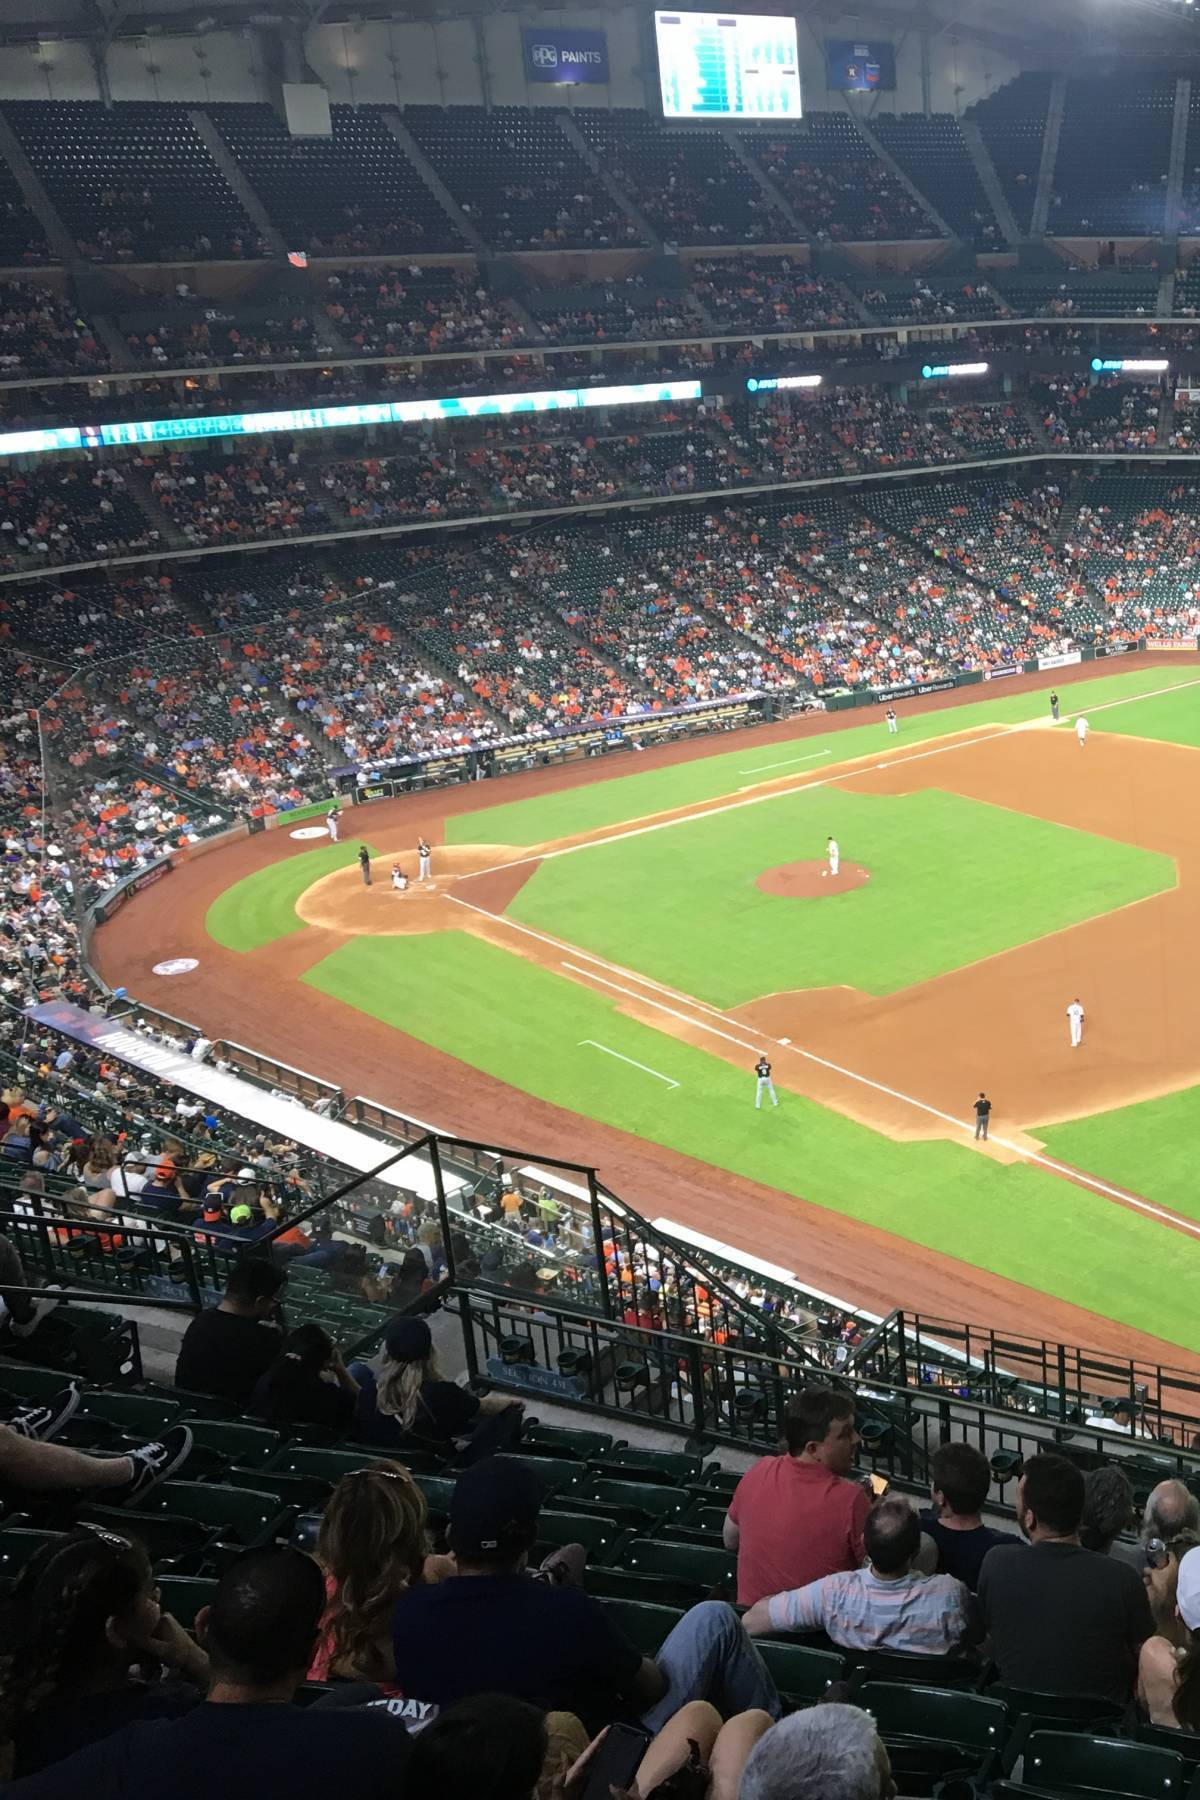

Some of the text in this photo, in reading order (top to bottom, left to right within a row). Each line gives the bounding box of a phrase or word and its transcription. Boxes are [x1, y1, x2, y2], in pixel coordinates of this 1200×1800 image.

[562, 50, 601, 63] PAINTS
[1147, 640, 1197, 649] WELLS FARGO
[919, 681, 953, 694] Uber Rewards
[894, 689, 915, 699] Rewards
